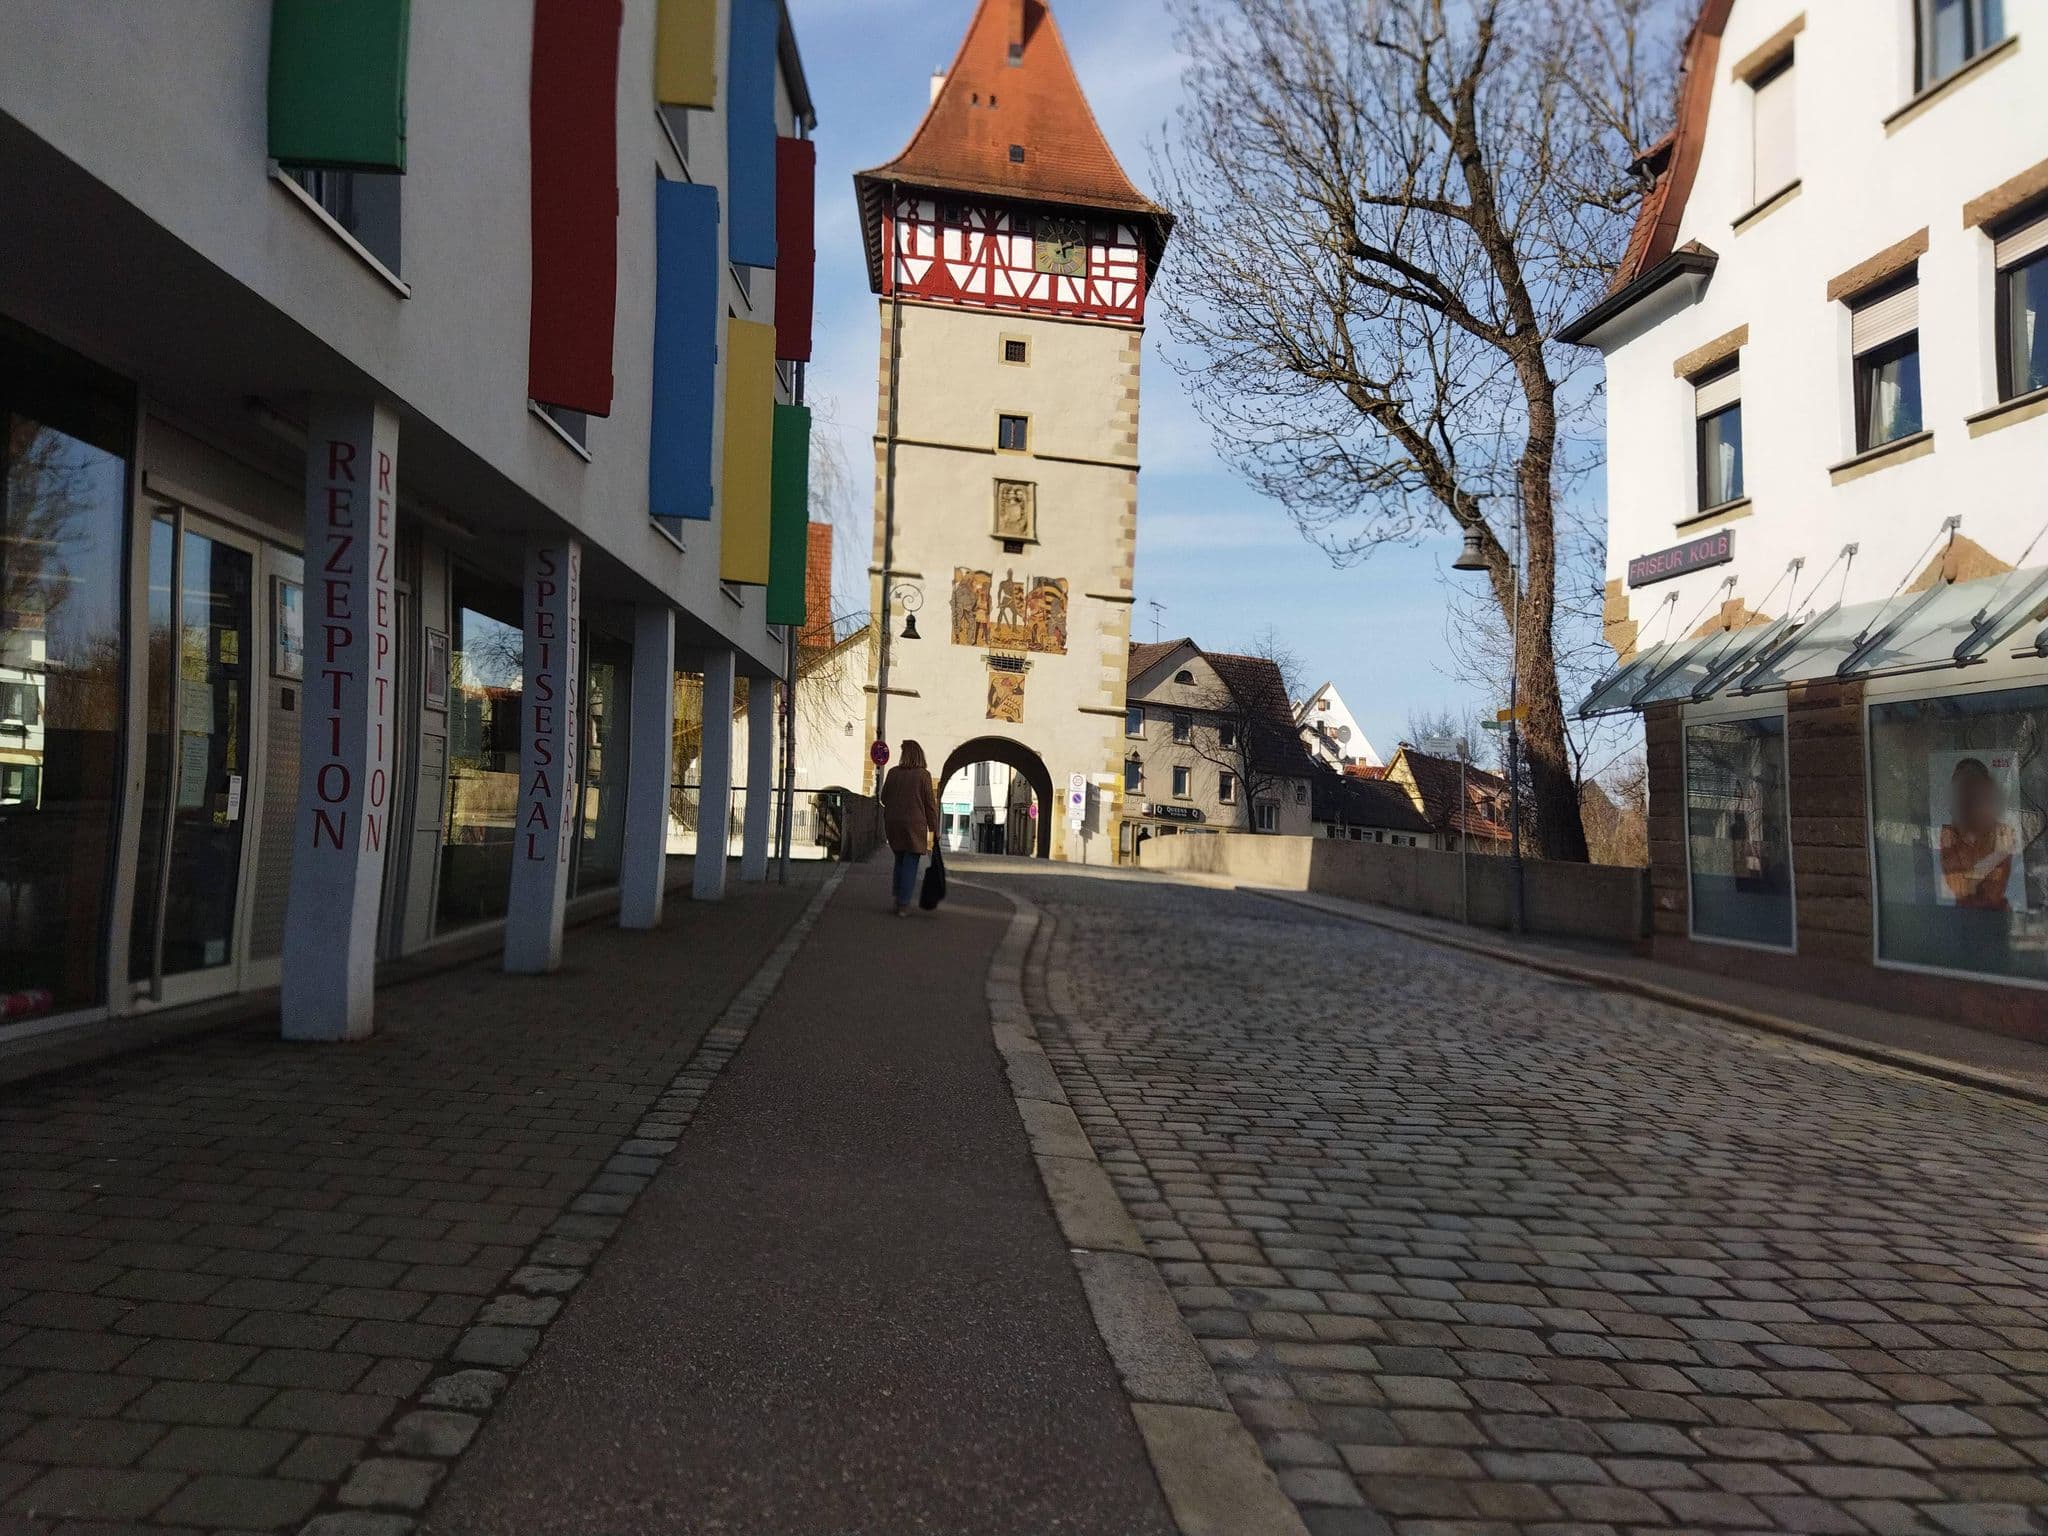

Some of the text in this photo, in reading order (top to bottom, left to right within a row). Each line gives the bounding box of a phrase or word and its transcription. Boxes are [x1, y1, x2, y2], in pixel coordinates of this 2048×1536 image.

[312, 439, 357, 851] REZEPTION
[366, 450, 391, 853] REZEPTION
[526, 549, 556, 862] SPEISESAAL
[560, 554, 578, 864] SPEISESAAL
[1629, 536, 1729, 579] FRISEUR KOLB
